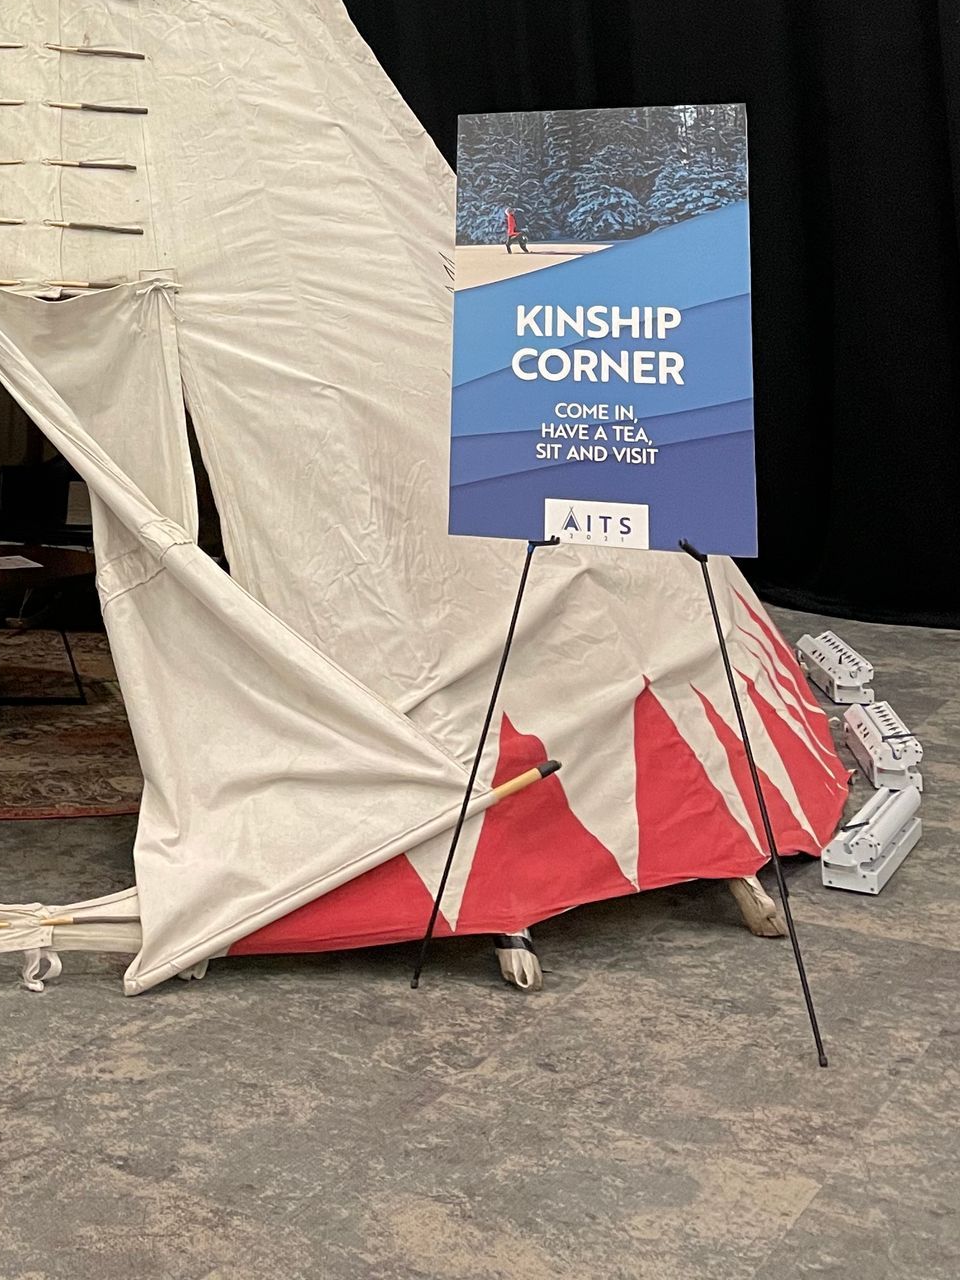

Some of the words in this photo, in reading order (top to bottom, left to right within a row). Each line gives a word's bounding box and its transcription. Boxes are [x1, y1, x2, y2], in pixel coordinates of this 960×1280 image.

[516, 304, 682, 340] KINSHIP
[511, 347, 685, 386] CORNER
[554, 402, 610, 420] COME
[614, 404, 638, 424] IN,
[541, 422, 590, 440] HAVE
[593, 425, 608, 441] A
[611, 425, 653, 446] TEA,
[535, 442, 563, 460] SIT
[566, 445, 608, 462] AND
[611, 446, 659, 465] VISIT
[562, 511, 631, 535] AITS
